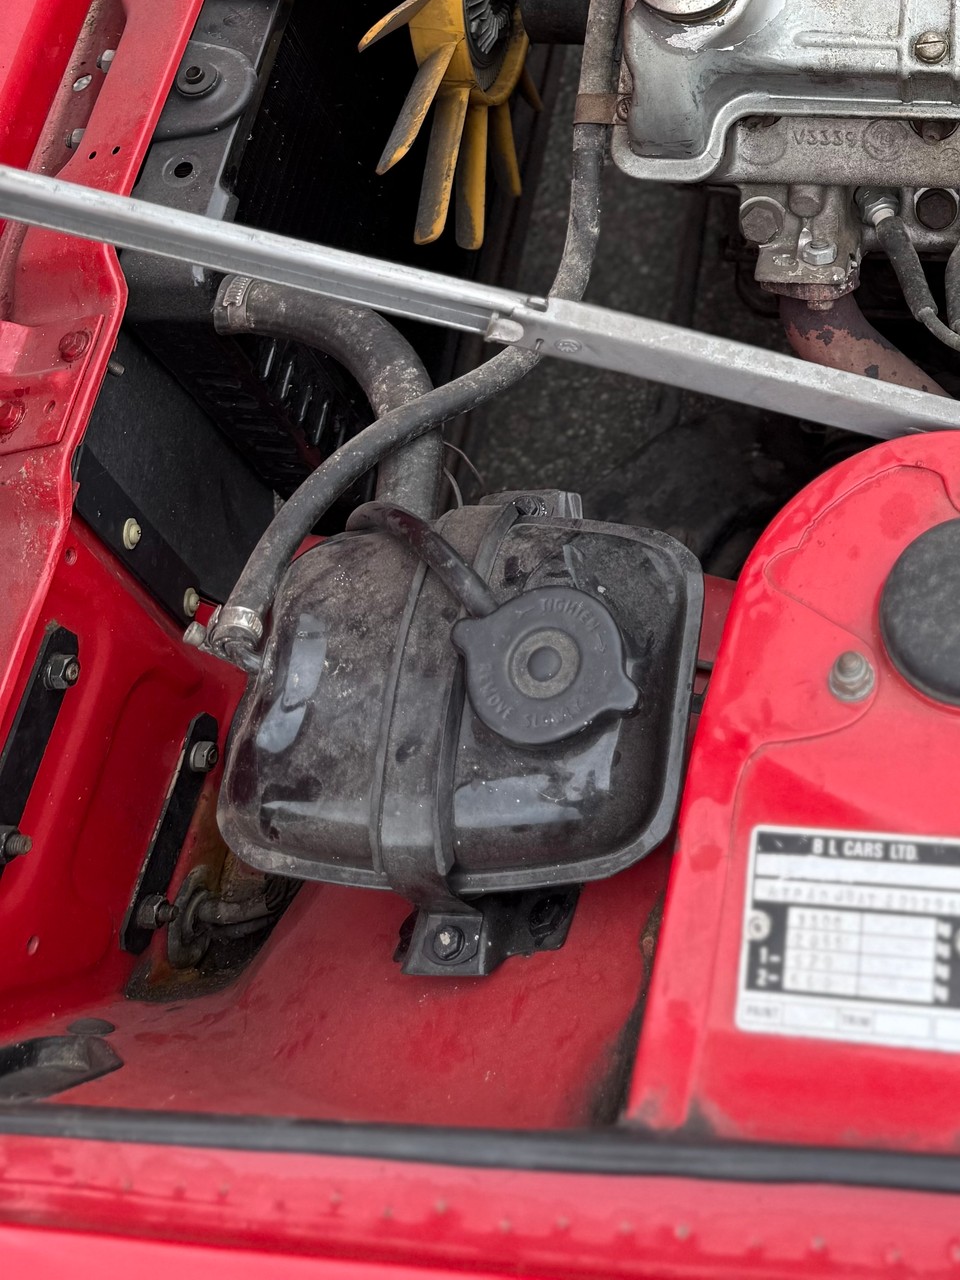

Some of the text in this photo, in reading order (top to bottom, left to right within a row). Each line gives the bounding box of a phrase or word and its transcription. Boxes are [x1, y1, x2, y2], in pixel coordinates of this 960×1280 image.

[540, 597, 600, 631] TIGHTEN
[813, 837, 824, 855] B
[829, 839, 838, 856] L
[843, 840, 884, 859] CARS
